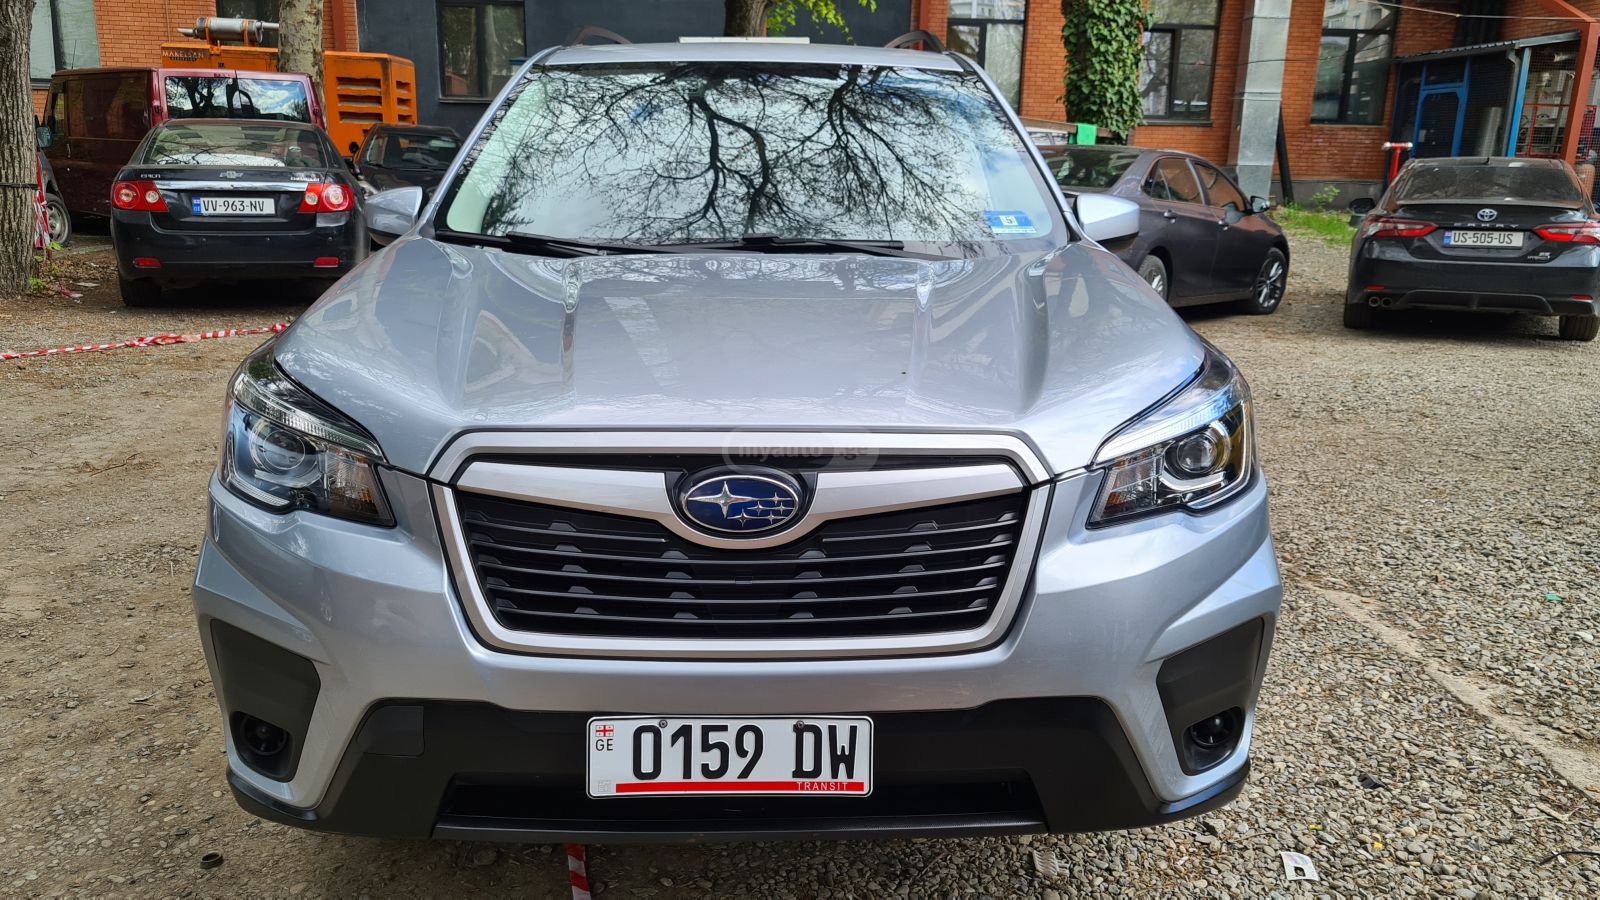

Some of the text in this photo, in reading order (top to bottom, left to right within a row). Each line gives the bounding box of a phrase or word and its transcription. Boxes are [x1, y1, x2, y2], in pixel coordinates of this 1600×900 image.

[202, 199, 265, 212] VV-963-NV
[1453, 232, 1514, 245] US-505-US
[595, 738, 614, 751] GE
[632, 723, 858, 780] 0159 DW
[796, 781, 848, 791] TRANSIT
